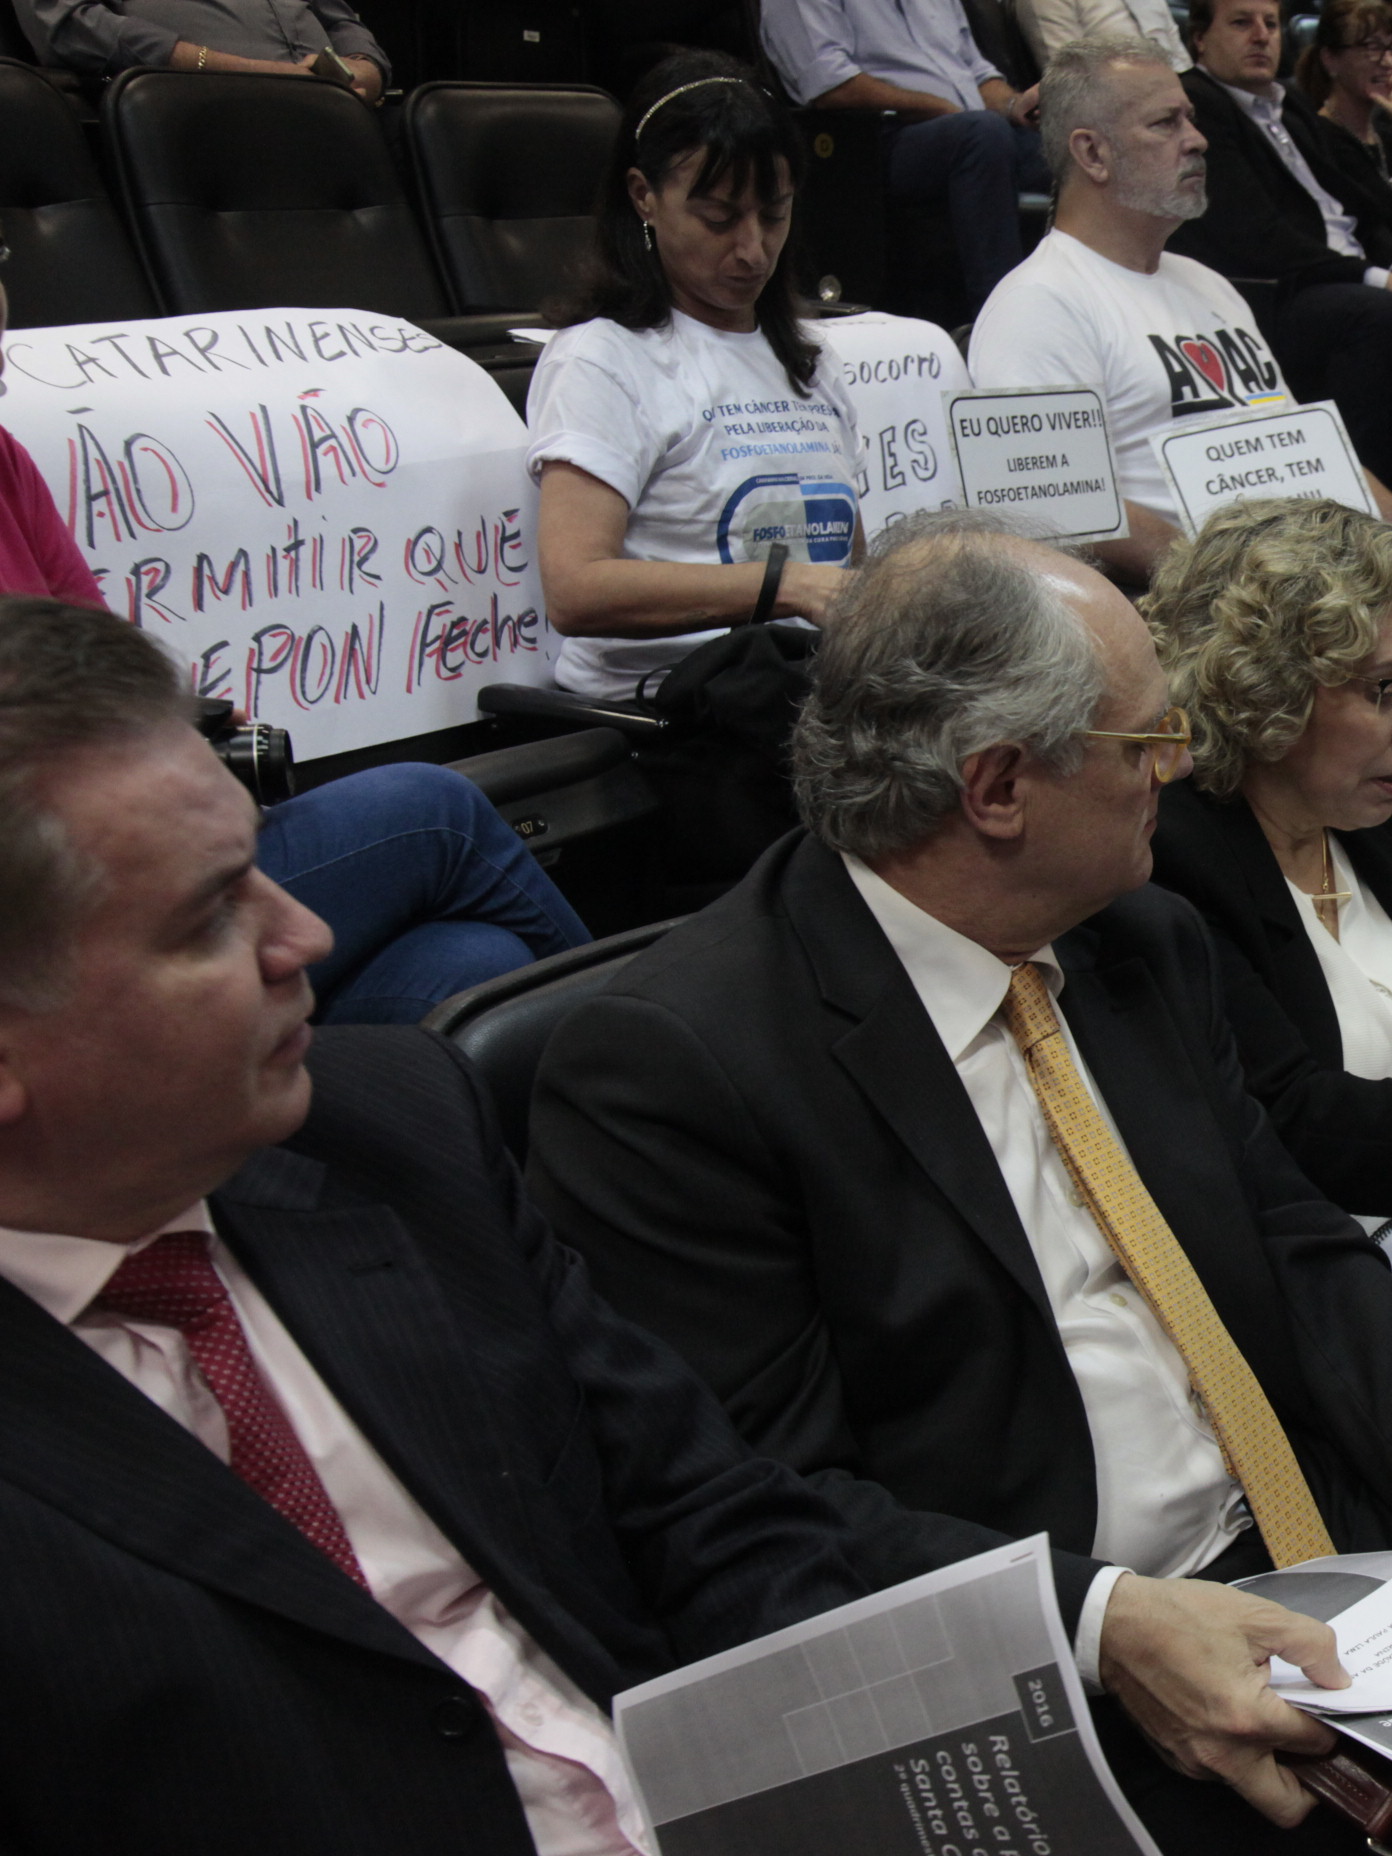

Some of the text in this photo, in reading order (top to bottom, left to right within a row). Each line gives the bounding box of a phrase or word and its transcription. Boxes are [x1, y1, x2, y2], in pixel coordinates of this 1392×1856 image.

[6, 321, 443, 388] CATARINENSES
[717, 403, 743, 417] TEM
[745, 399, 790, 414] CÂNCER
[724, 423, 755, 436] PELA
[756, 417, 815, 435] LIBERAÇÃO
[960, 418, 981, 438] EU
[986, 413, 1043, 438] QUERO
[206, 388, 400, 508] VÃO
[720, 441, 831, 461] FOSFOETANOLAMINA
[1007, 453, 1070, 472] LIBEREM A
[1206, 429, 1306, 462] QUEM TEM
[68, 406, 194, 549] ÃO
[977, 477, 1106, 505] FOSFOETANOLAMINA!
[1206, 467, 1284, 496] CÂNCER,
[1285, 457, 1325, 478] TEM
[405, 509, 528, 592] QUE
[192, 601, 384, 720] EPON
[1343, 1642, 1363, 1655] LIMA
[1027, 1678, 1054, 1728] 2016
[909, 1758, 948, 1836] Santa
[936, 1750, 980, 1840] contas
[961, 1742, 1000, 1818] sobre
[992, 1825, 1012, 1841] a
[988, 1735, 1051, 1856] Relatório
